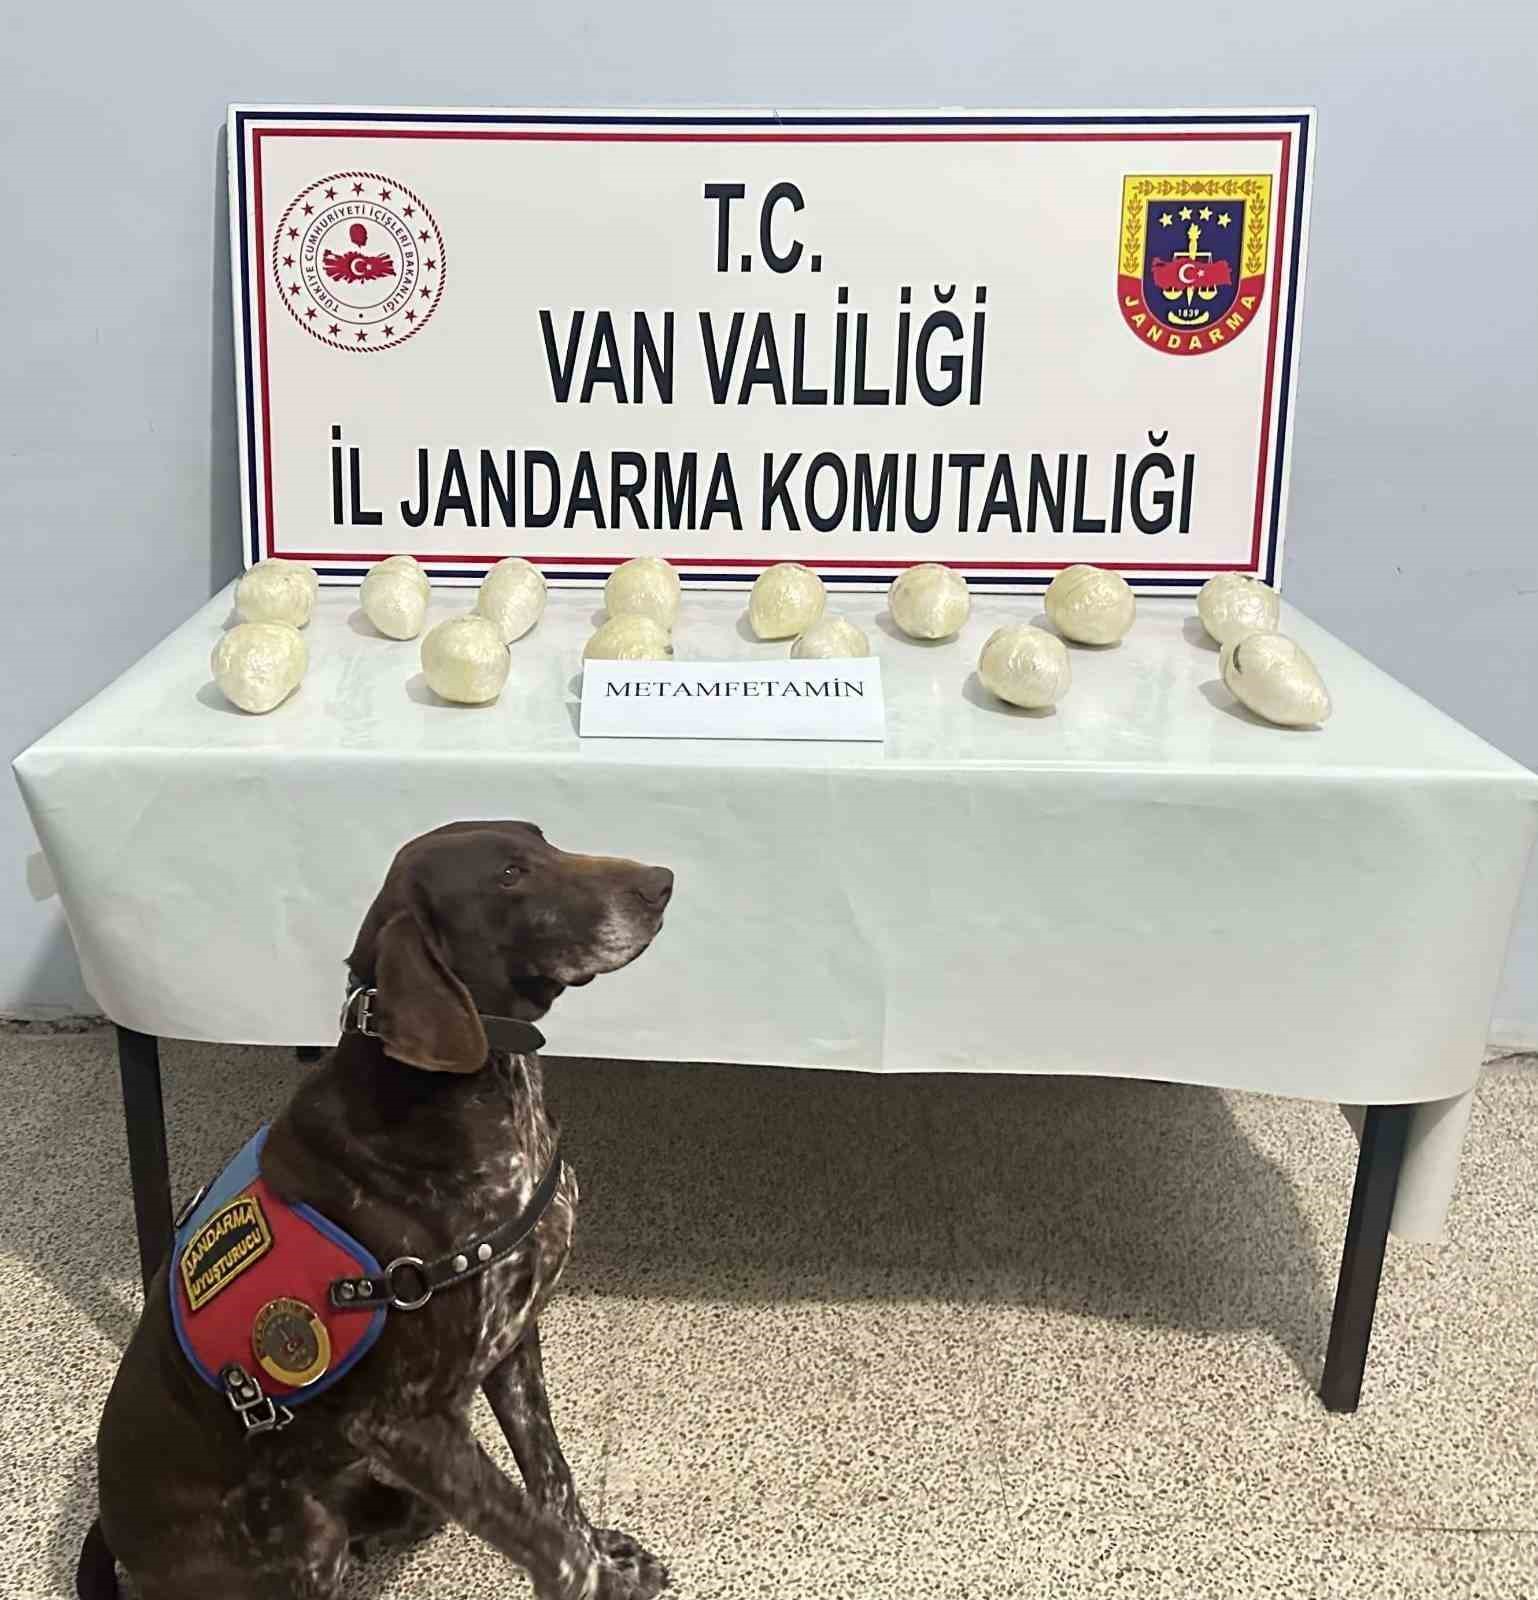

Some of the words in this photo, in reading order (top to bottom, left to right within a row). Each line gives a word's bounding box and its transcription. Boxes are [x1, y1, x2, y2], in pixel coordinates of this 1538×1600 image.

[304, 204, 365, 261] CUMHURİYETİ
[369, 206, 412, 248] İÇİŞLERİ
[704, 183, 822, 273] T.C.
[382, 251, 415, 314] BAKANLIĞI
[539, 311, 675, 404] VAN
[699, 285, 987, 406] VALİLİĞİ
[1125, 295, 1256, 350] JANDARMA
[331, 426, 382, 525] İL
[401, 449, 742, 530] JANDARMA
[762, 431, 1195, 534] KOMUTANLIĞI
[606, 677, 864, 698] METAMFETAMİN
[186, 1205, 256, 1275] JANDARMA
[192, 1228, 263, 1295] UYUŞTURUCU
